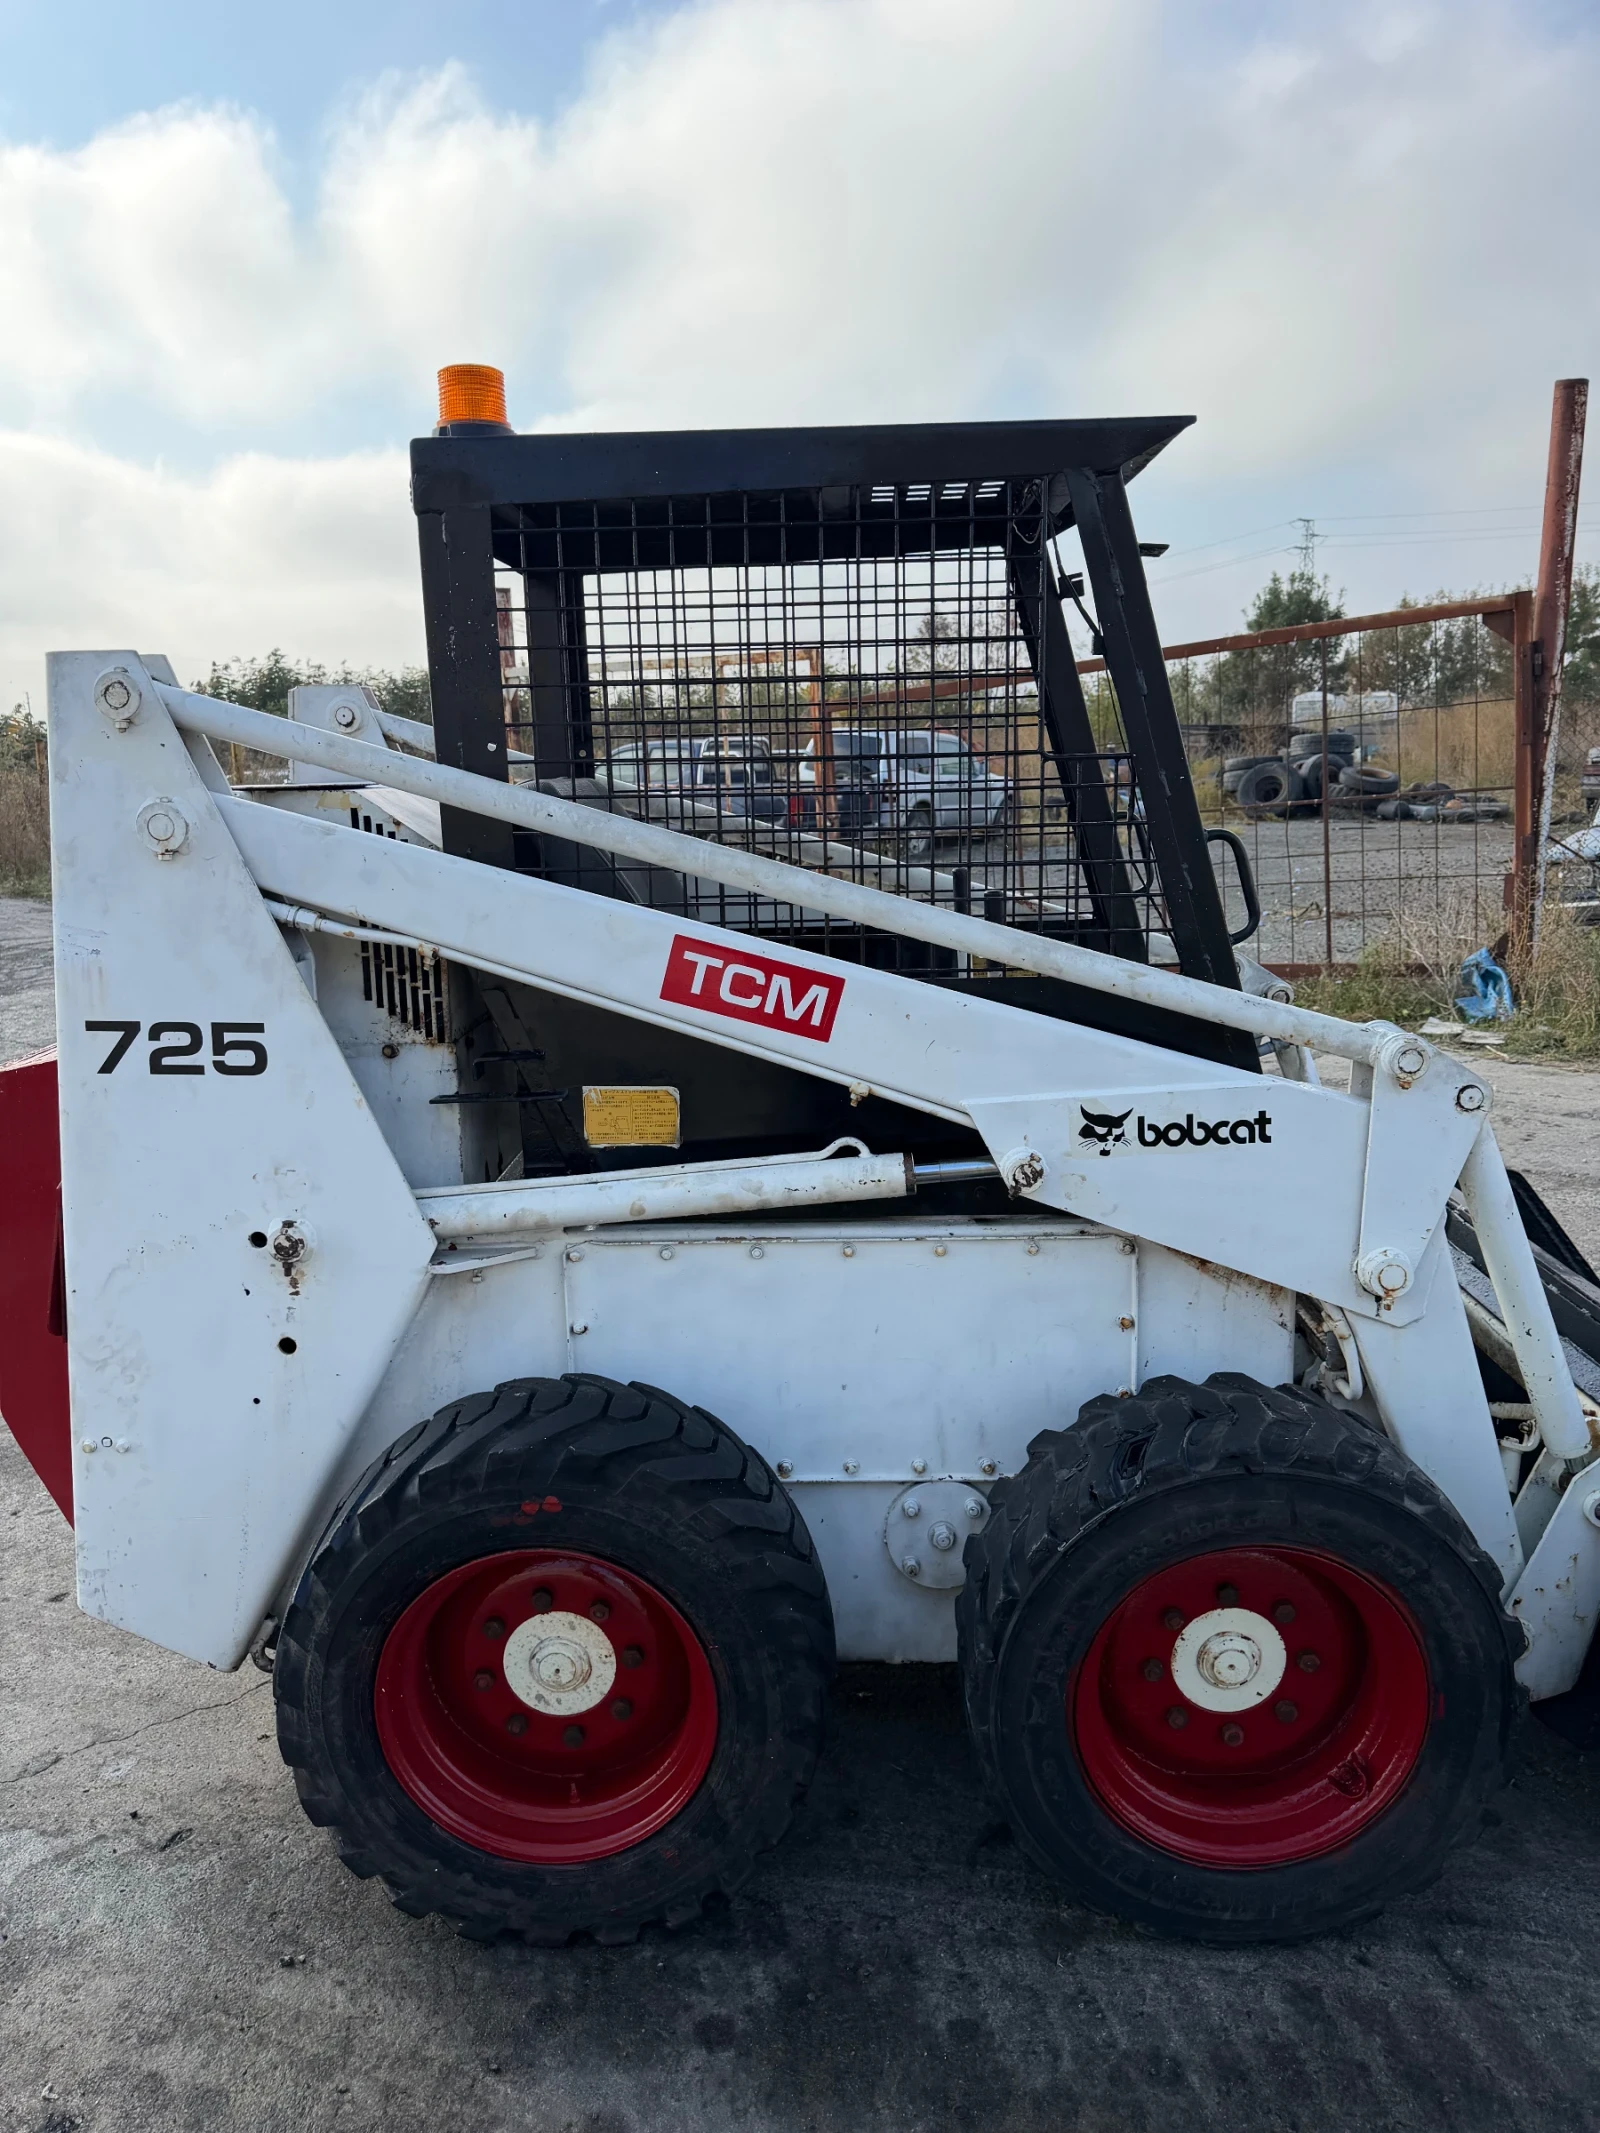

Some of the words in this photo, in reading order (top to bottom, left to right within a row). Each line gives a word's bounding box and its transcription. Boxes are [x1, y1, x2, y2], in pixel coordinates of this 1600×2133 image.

[683, 950, 830, 1027] TCM
[84, 1020, 269, 1076] 725
[1137, 1110, 1272, 1147] bobcat
